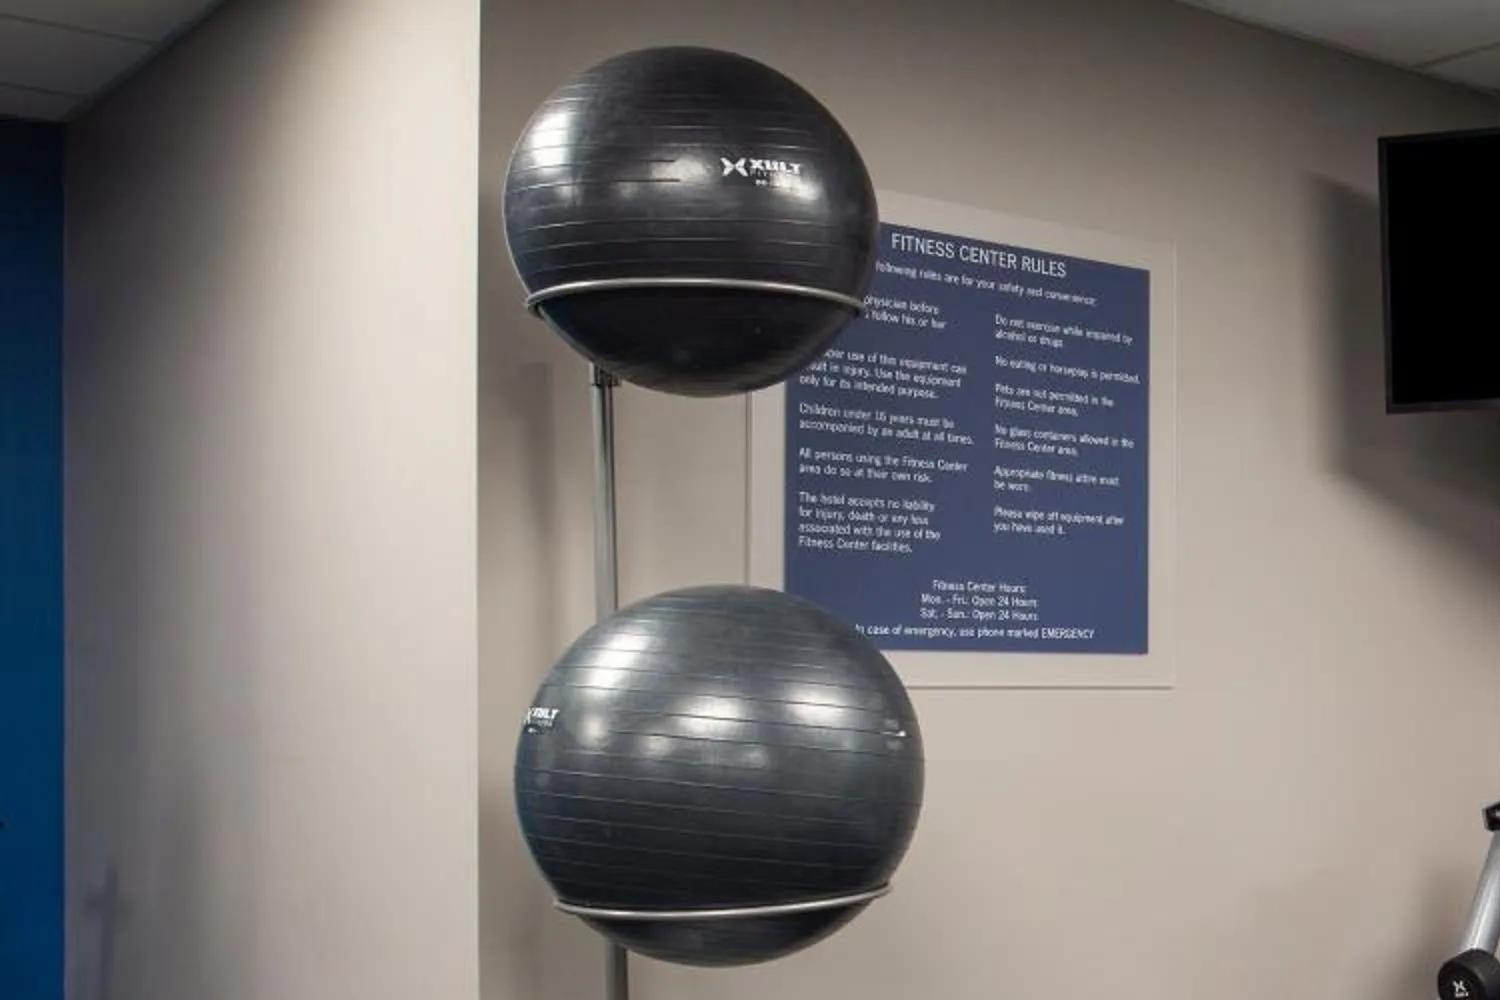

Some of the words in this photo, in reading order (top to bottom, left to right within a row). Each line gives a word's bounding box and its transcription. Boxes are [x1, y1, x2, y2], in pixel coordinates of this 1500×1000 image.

[749, 159, 801, 174] XULT
[891, 232, 955, 259] FITNESS
[959, 245, 1017, 271] CENTER
[1021, 256, 1067, 278] RULES
[995, 355, 1009, 367] No
[800, 374, 819, 387] only
[823, 376, 837, 387] for
[854, 379, 895, 396] intended
[875, 367, 892, 380] Use
[895, 369, 911, 382] the
[913, 374, 961, 389] equipment
[800, 401, 841, 418] Children
[843, 406, 871, 419] under
[1027, 399, 1056, 414] Center
[799, 418, 865, 434] accompanied
[867, 423, 879, 438] by
[896, 428, 919, 440] adult
[1027, 441, 1056, 454] Center
[799, 447, 811, 458] All
[814, 450, 853, 462] persons
[855, 453, 881, 467] using
[883, 454, 899, 466] the
[902, 456, 935, 470] Fitness
[937, 459, 968, 473] Center
[799, 463, 821, 475] area
[823, 464, 837, 475] do
[839, 466, 853, 477] so
[854, 467, 865, 478] at
[867, 467, 889, 480] their
[891, 471, 911, 482] own
[993, 479, 1006, 490] be
[799, 491, 817, 503] The
[820, 493, 845, 505] hotel
[847, 497, 885, 510] accepts
[887, 498, 900, 509] no
[902, 499, 936, 513] liability
[799, 506, 813, 518] for
[847, 509, 875, 522] death
[878, 513, 888, 523] or
[891, 513, 909, 527] any
[911, 513, 929, 526] loss
[993, 505, 1023, 520] Please
[798, 522, 850, 536] associated
[853, 525, 873, 537] with
[875, 525, 891, 538] the
[894, 528, 911, 539] use
[913, 528, 923, 540] of
[925, 529, 941, 543] the
[993, 523, 1010, 534] you
[799, 536, 834, 549] Fitness
[836, 537, 869, 551] Center
[932, 579, 965, 592] Fitness
[967, 581, 996, 593] Center
[997, 596, 1010, 607] 24
[997, 609, 1010, 621] 24
[867, 625, 890, 635] case
[891, 623, 902, 635] of
[959, 628, 975, 637] use
[977, 628, 1005, 639] phone
[1007, 628, 1039, 639] marked
[1041, 628, 1095, 639] EMERGENCY
